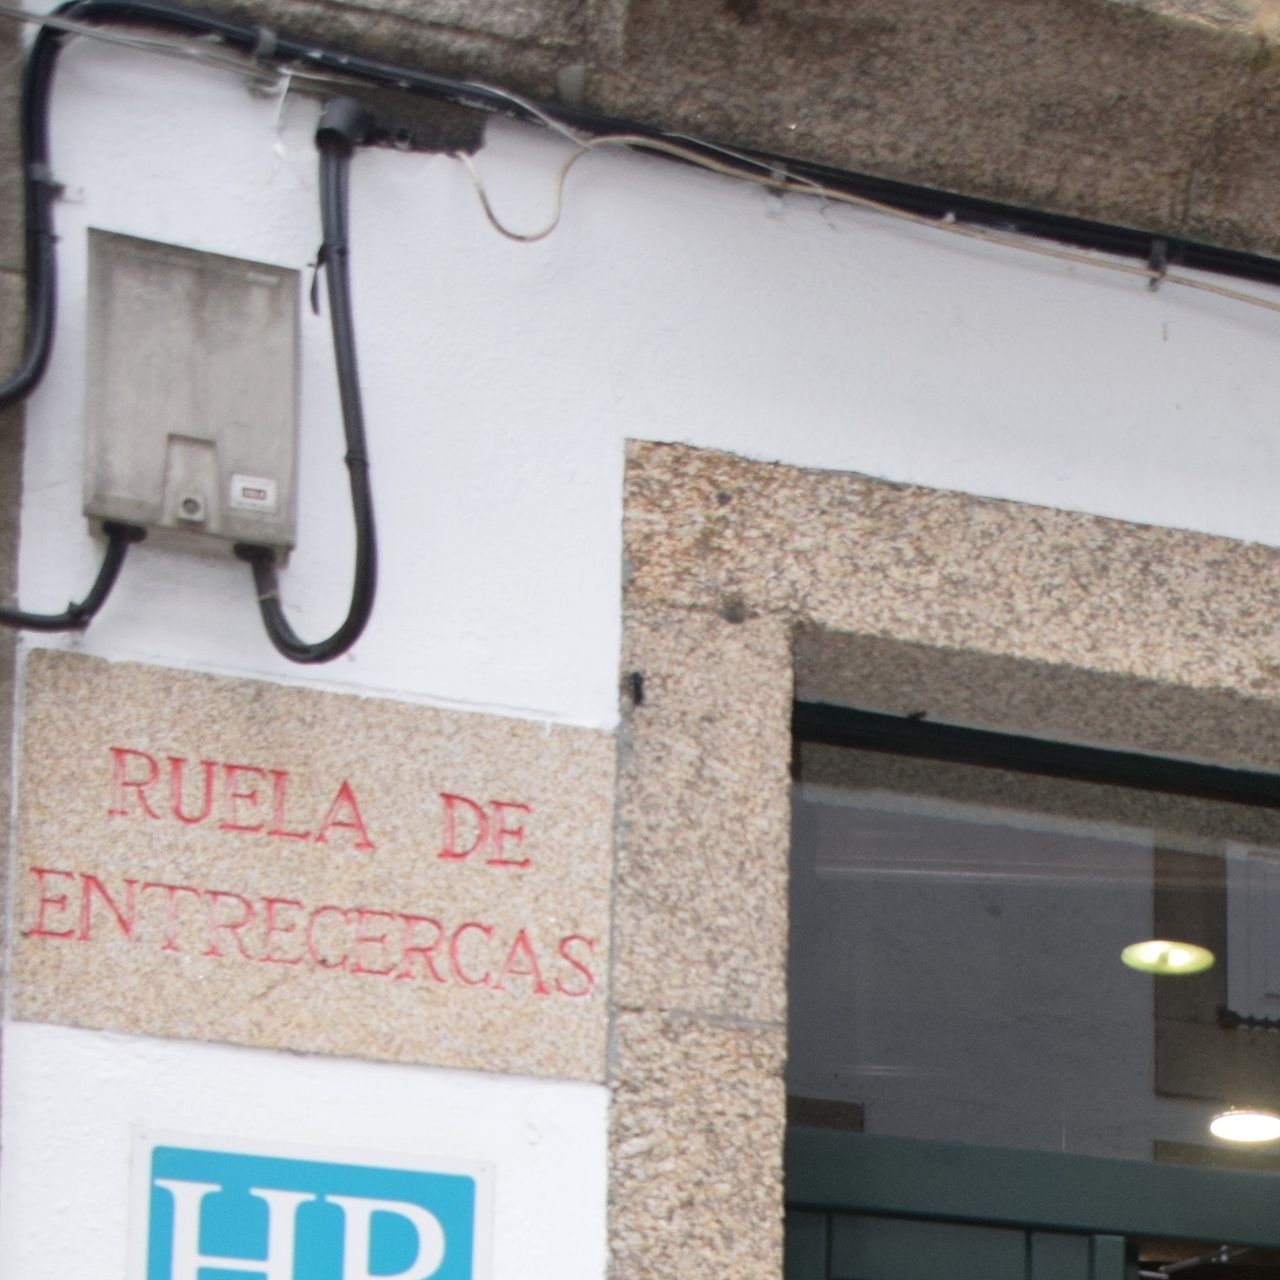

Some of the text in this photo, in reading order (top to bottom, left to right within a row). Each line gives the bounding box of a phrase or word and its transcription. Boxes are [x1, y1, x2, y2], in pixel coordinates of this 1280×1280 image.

[107, 746, 533, 868] RUELA DE
[23, 866, 596, 997] ENTRECERCAS
